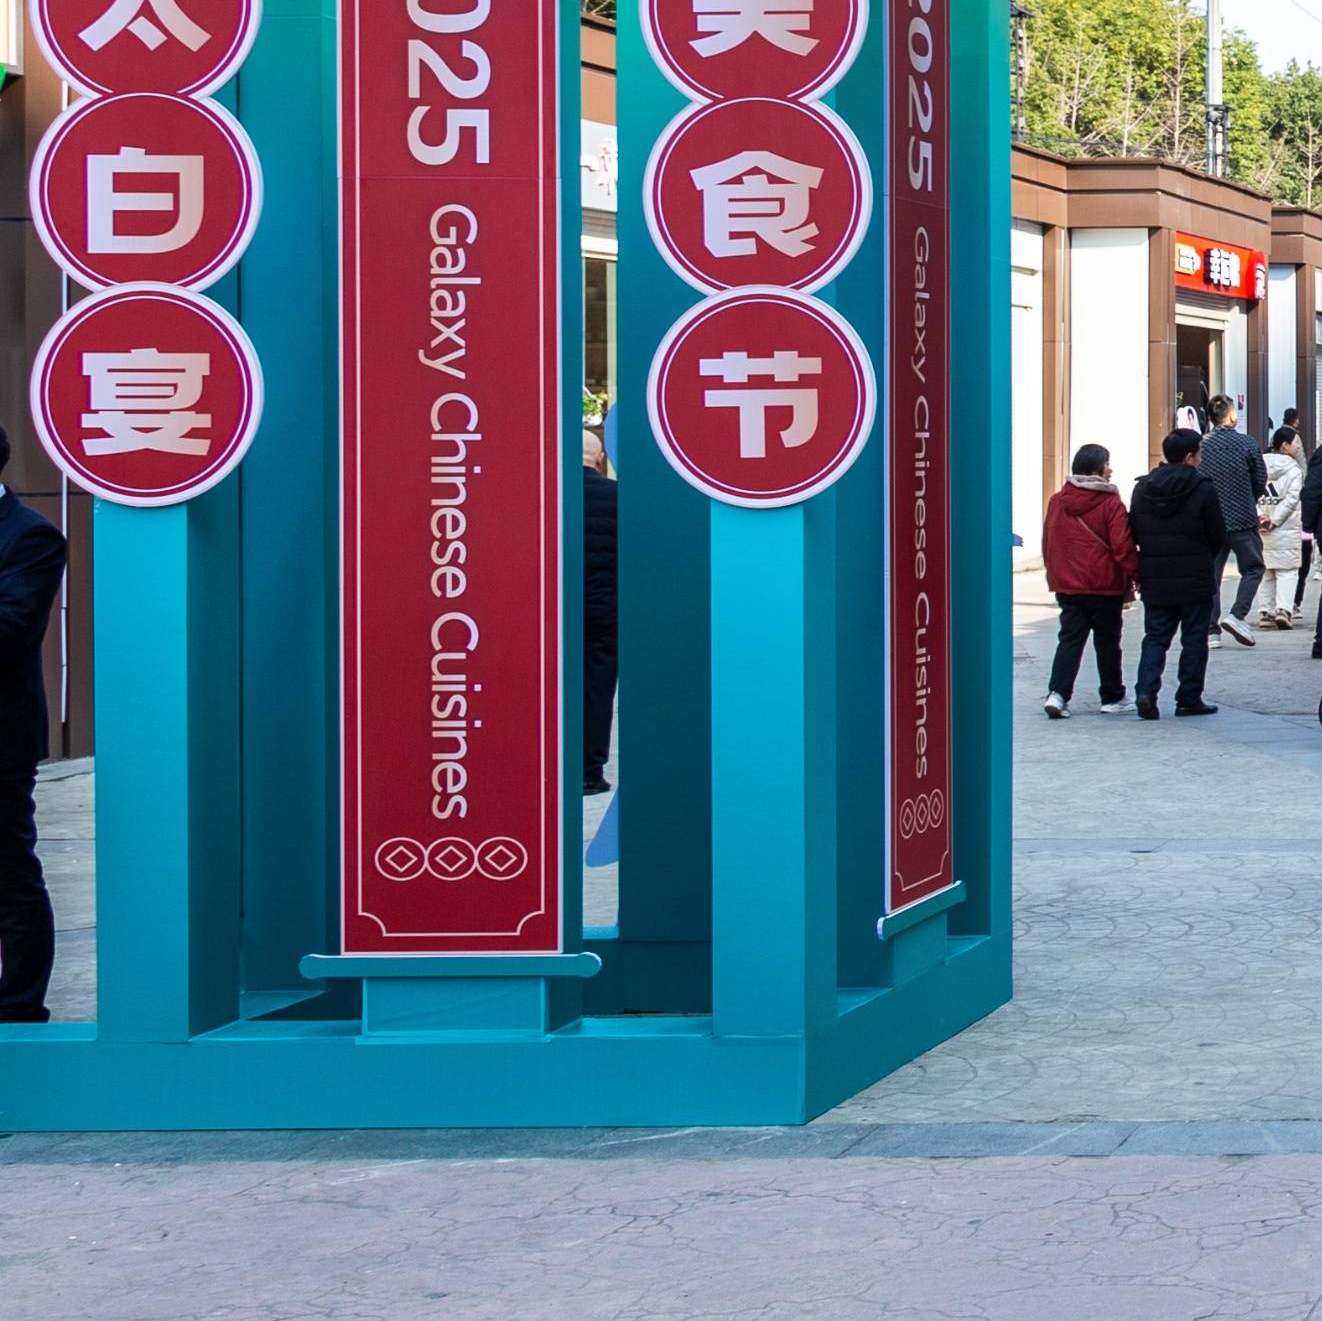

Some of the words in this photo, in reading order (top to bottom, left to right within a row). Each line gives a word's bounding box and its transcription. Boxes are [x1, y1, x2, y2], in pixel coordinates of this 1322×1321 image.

[419, 204, 481, 379] Galaxy
[911, 227, 931, 382] Galaxy
[431, 393, 481, 598] Chinese
[914, 395, 931, 580] Chinese
[431, 612, 481, 819] Cuisines
[915, 591, 931, 779] Cuisines
